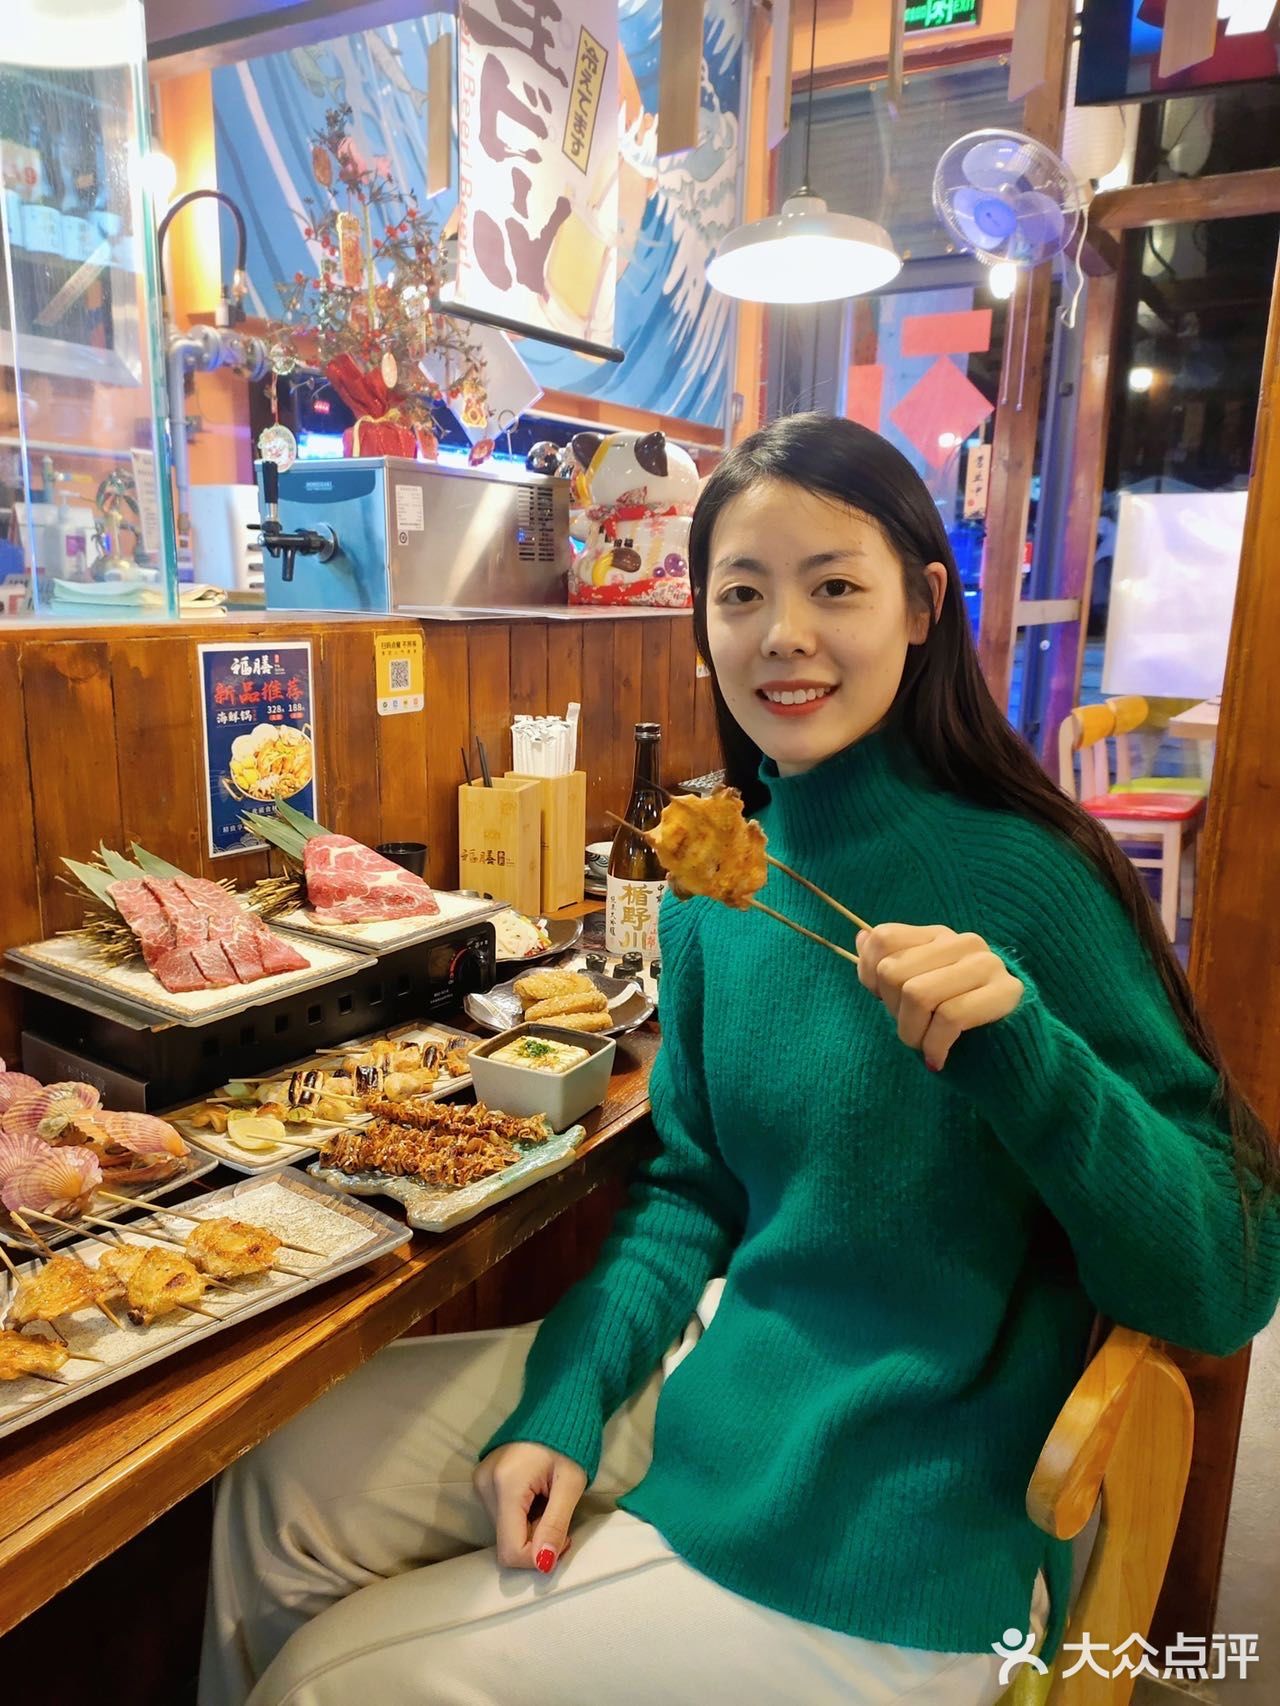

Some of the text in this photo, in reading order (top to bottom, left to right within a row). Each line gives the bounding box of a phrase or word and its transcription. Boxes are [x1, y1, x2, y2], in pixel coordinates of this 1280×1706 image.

[461, 73, 476, 169] Beer!
[459, 177, 473, 270] Beer!
[214, 677, 305, 705] 新品推荐
[618, 883, 654, 950] 楯野川
